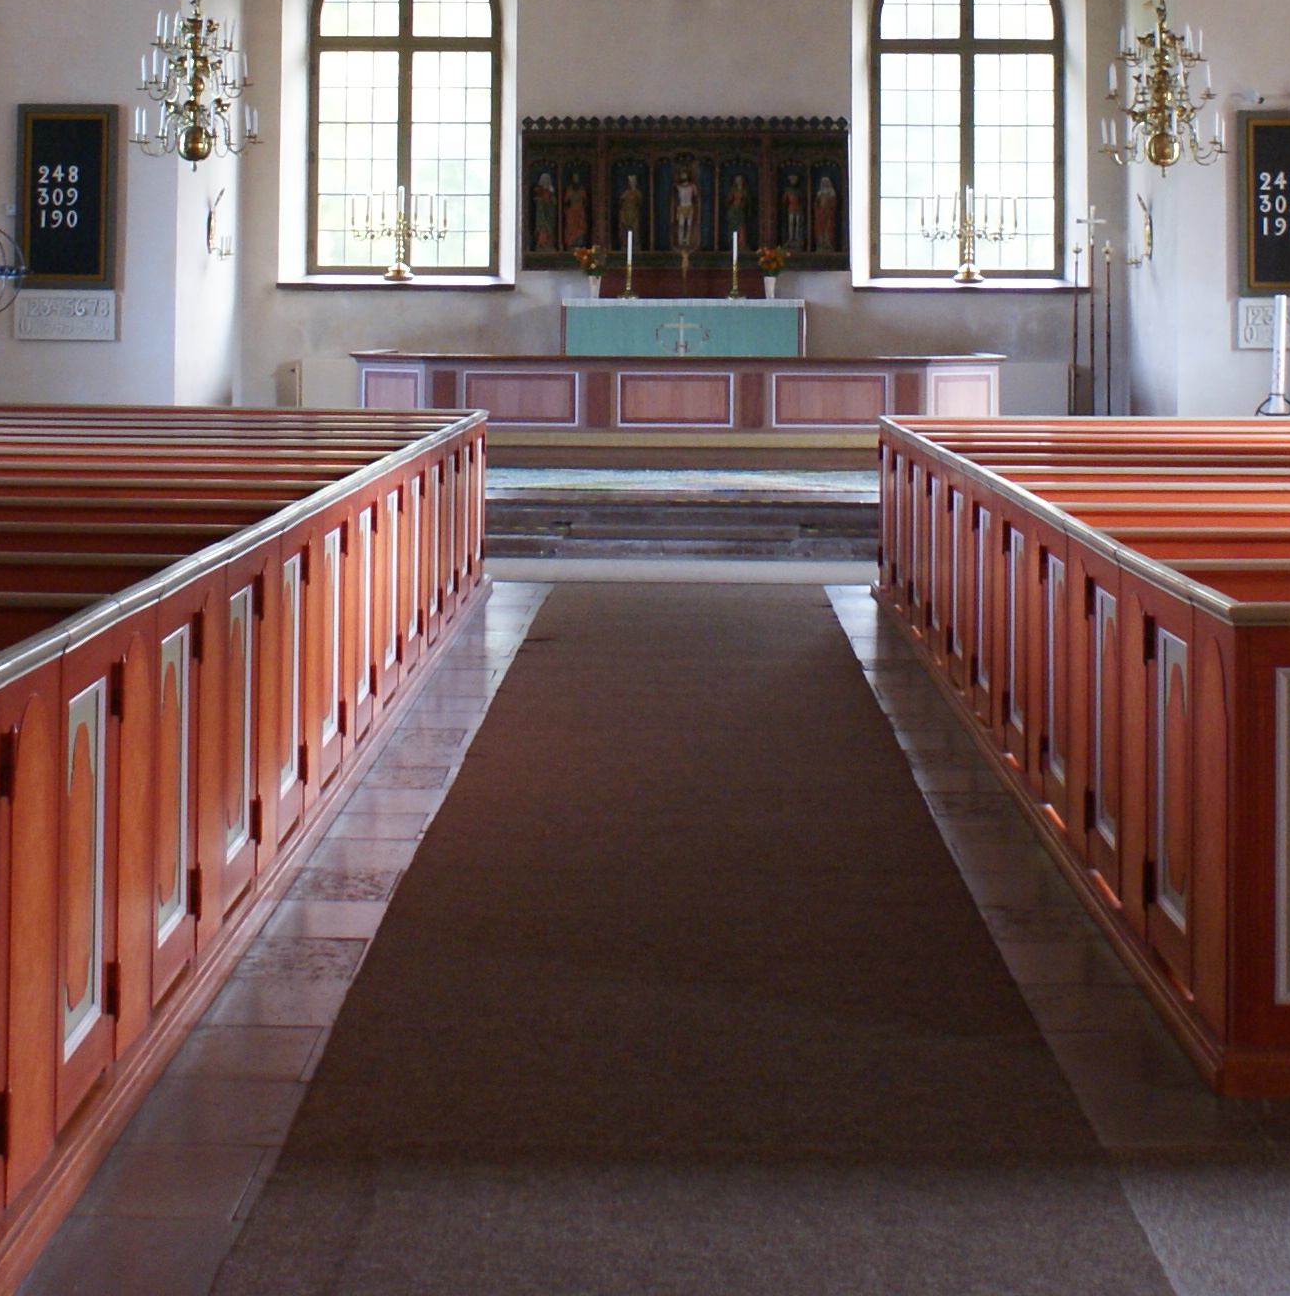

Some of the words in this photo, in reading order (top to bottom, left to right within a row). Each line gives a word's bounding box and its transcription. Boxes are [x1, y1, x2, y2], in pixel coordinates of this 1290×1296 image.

[38, 164, 79, 183] 248
[37, 188, 79, 206] 309
[40, 209, 78, 228] 190
